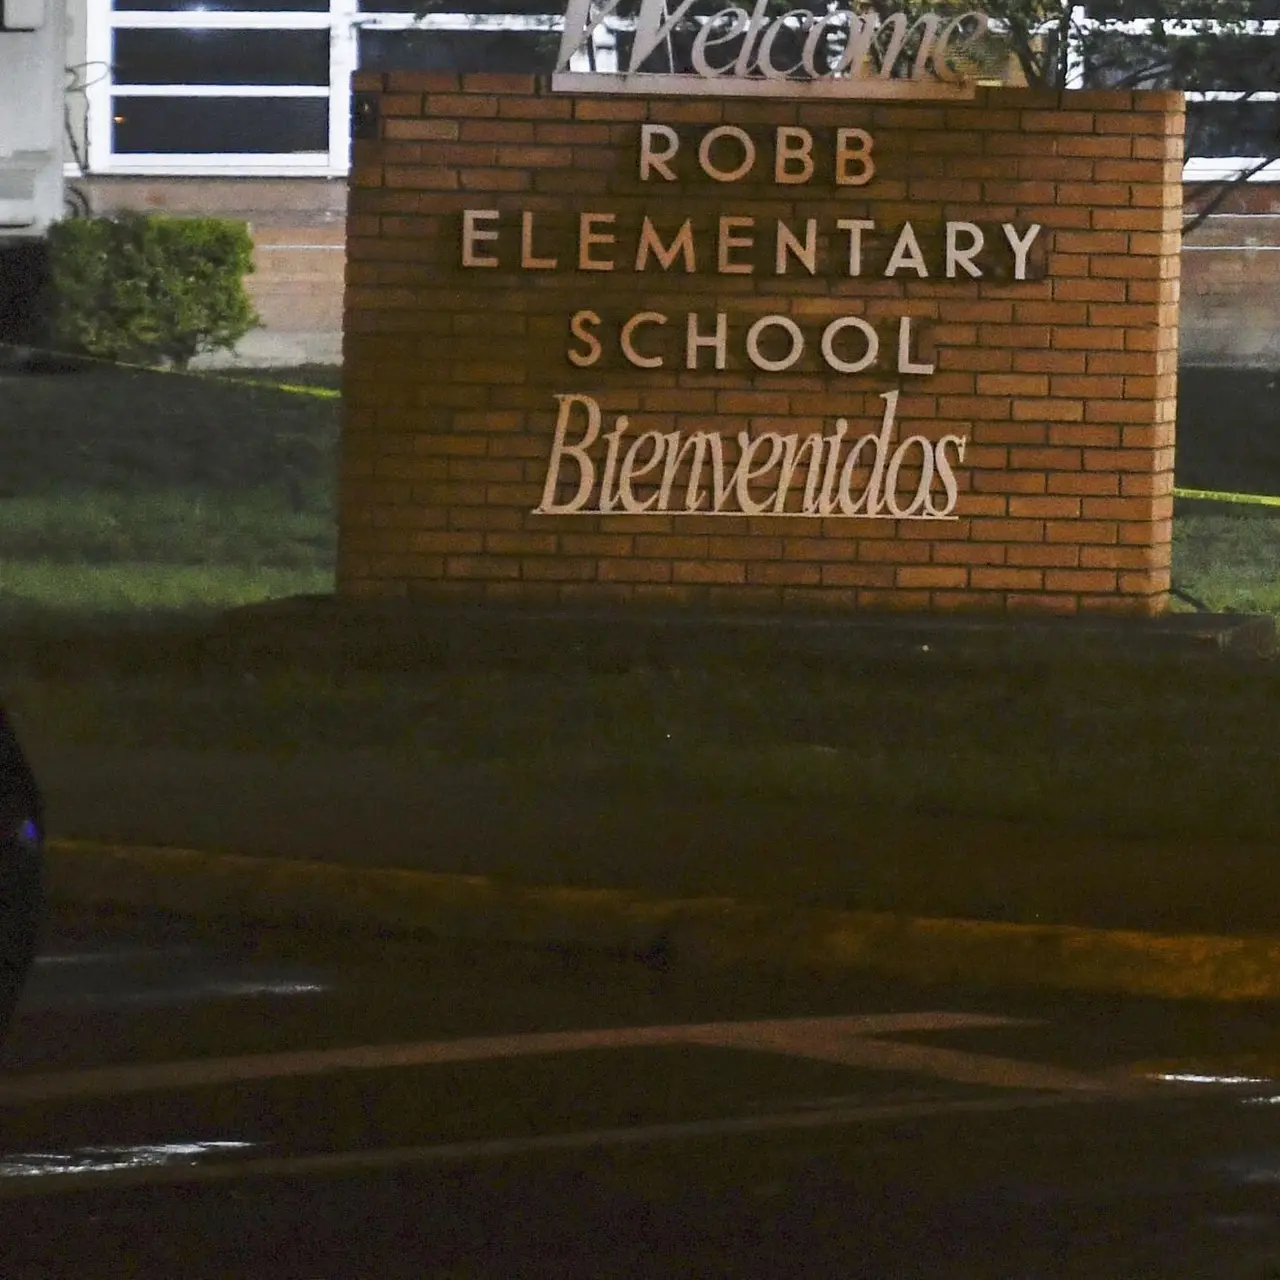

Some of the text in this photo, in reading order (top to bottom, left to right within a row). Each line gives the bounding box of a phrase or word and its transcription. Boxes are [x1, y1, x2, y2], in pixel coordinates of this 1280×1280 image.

[640, 123, 876, 186] ROBB
[461, 209, 1043, 280] ELEMENTARY
[567, 310, 935, 376] SCHOOL
[536, 390, 967, 518] Bienvenidos
